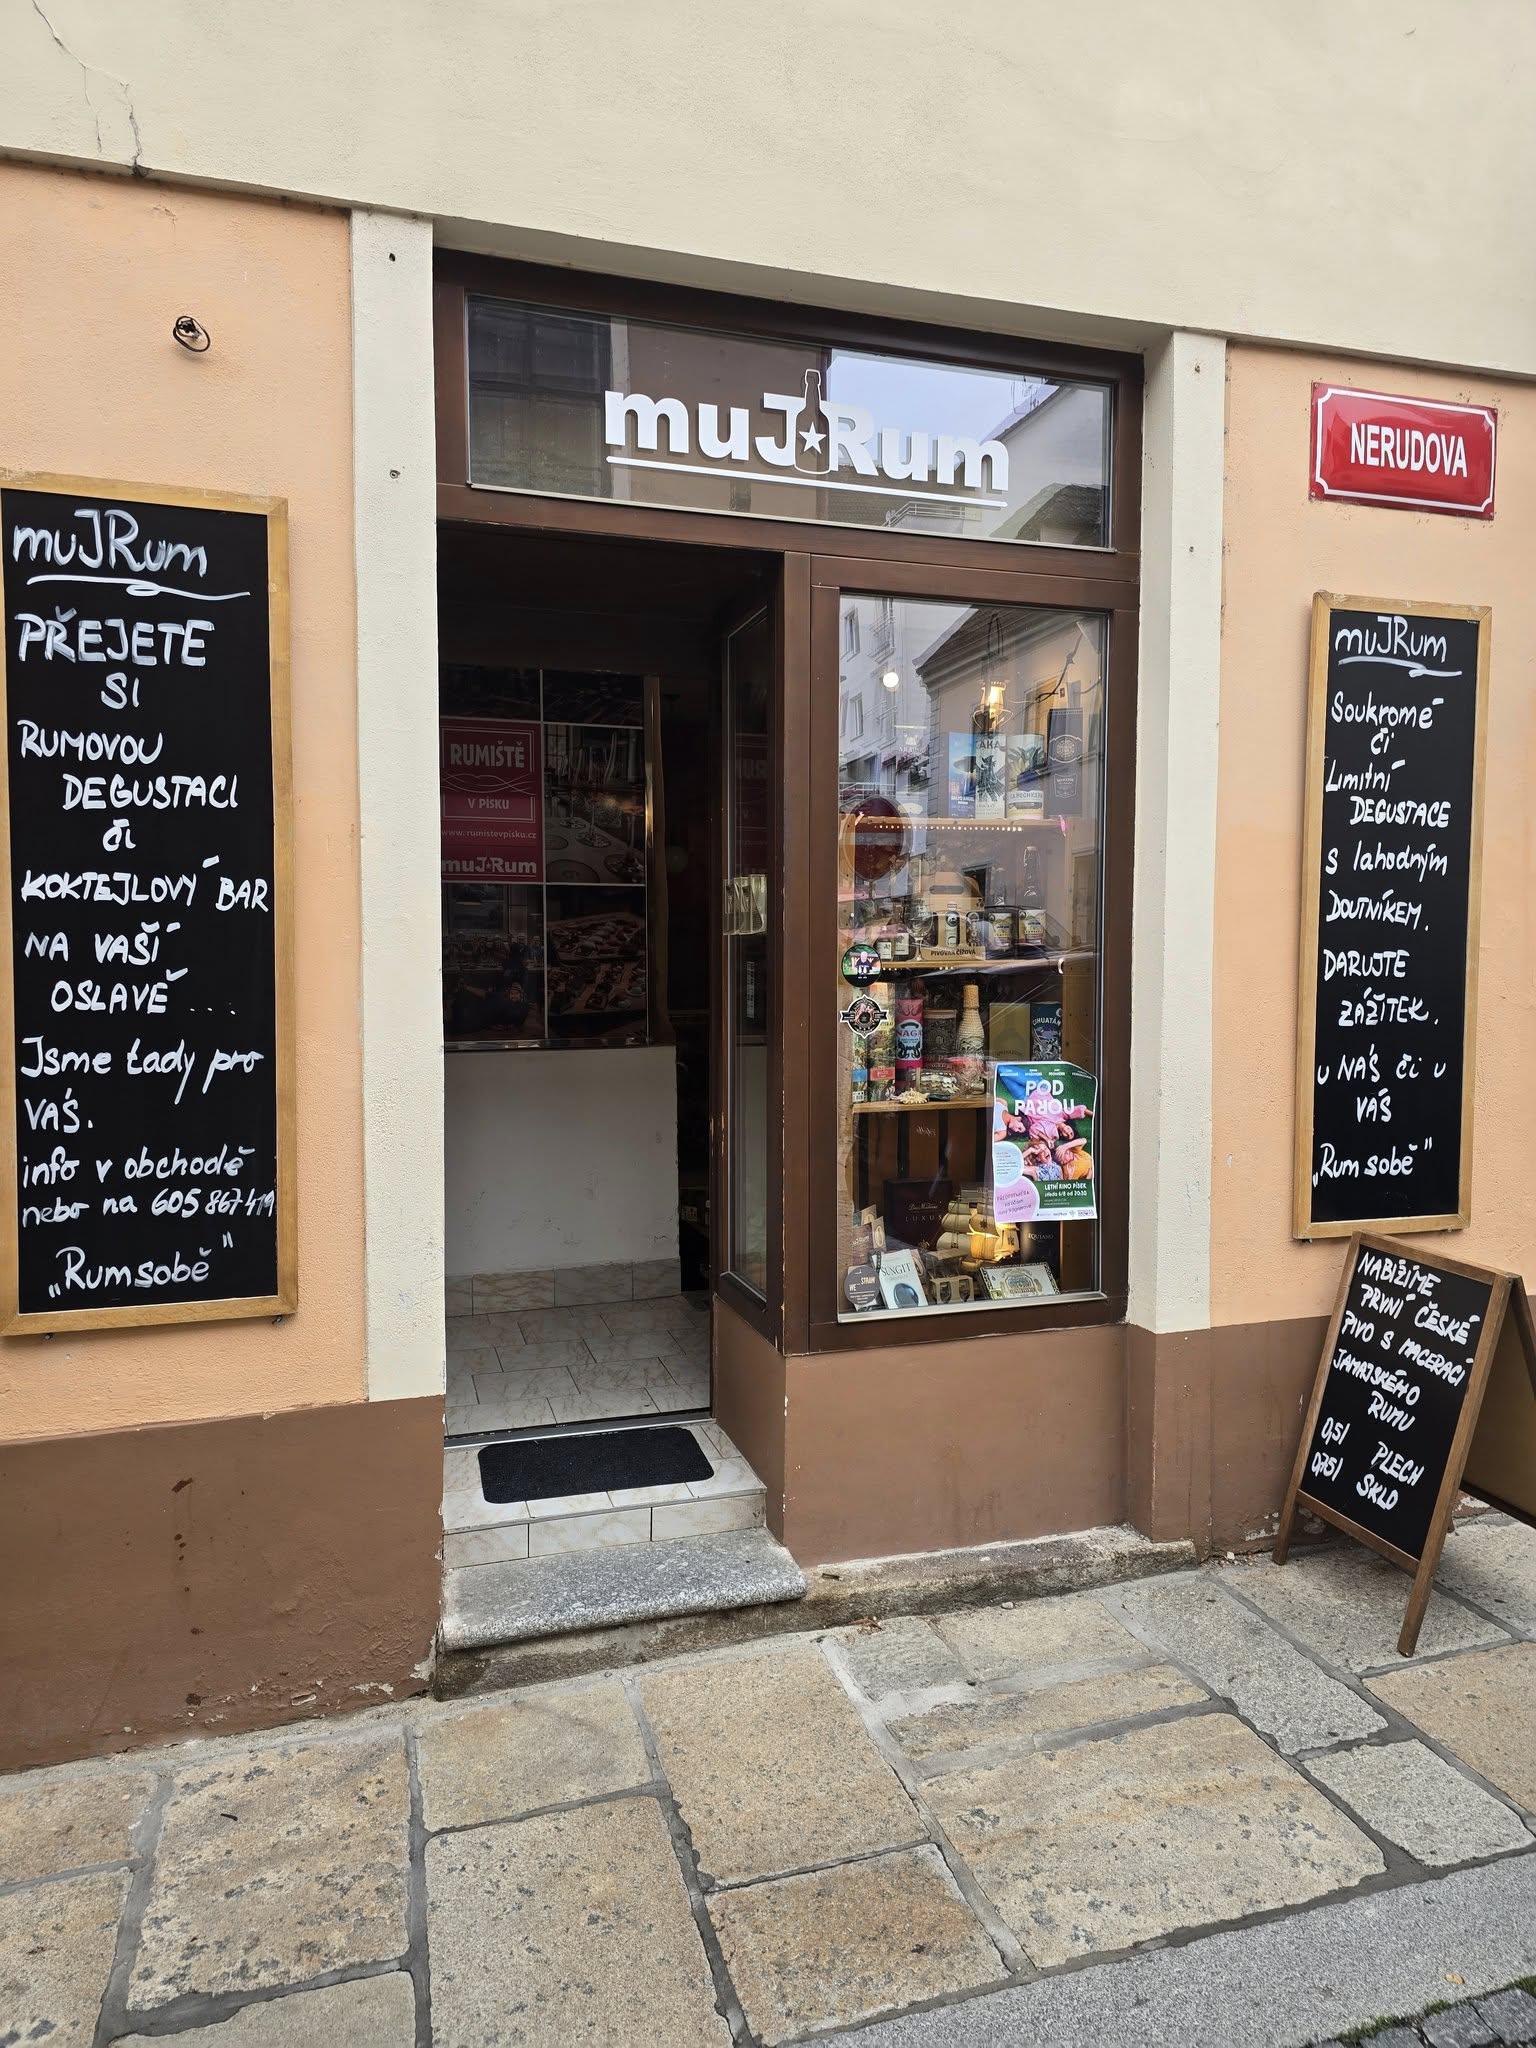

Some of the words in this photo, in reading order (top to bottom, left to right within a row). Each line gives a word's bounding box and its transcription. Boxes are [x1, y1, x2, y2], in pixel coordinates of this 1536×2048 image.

[1351, 422, 1468, 478] NERUDOVA
[12, 509, 208, 577] muJRum
[14, 606, 215, 666] PŘEJETE
[101, 672, 140, 709] SI
[1331, 690, 1444, 729] Soukromé
[17, 719, 163, 765] RUMOVOU
[450, 740, 525, 768] RUMIŠTĚ
[63, 773, 239, 810] DEGUSTACI
[1325, 759, 1406, 793] Limitní
[468, 798, 476, 809] V
[478, 796, 510, 810] PÍSKU
[1349, 795, 1451, 828] DEGUSTACE
[1353, 840, 1448, 883] lahodným
[216, 876, 269, 912] BAR
[24, 931, 69, 961] NA
[1323, 949, 1410, 981] DARUJTE
[21, 1035, 112, 1077] Jsme
[126, 1038, 196, 1105] tady
[202, 1048, 265, 1094] pro
[1025, 1079, 1064, 1096] POD
[22, 1145, 80, 1189] info
[96, 1158, 114, 1184] v
[124, 1143, 256, 1179] obchodě
[21, 1196, 90, 1228] nebo
[103, 1195, 138, 1216] na
[151, 1188, 202, 1218] 605
[1361, 1283, 1416, 1320] PRVNÍ
[1414, 1301, 1480, 1345] ČESKÉ
[1341, 1310, 1375, 1343] PIVO
[1398, 1337, 1474, 1387] MACERACÍ
[1333, 1348, 1421, 1406] JAMAJSKÉHO
[1367, 1391, 1416, 1432] RUMU
[1370, 1440, 1425, 1487] PLECH
[1356, 1473, 1399, 1511] SKLO
